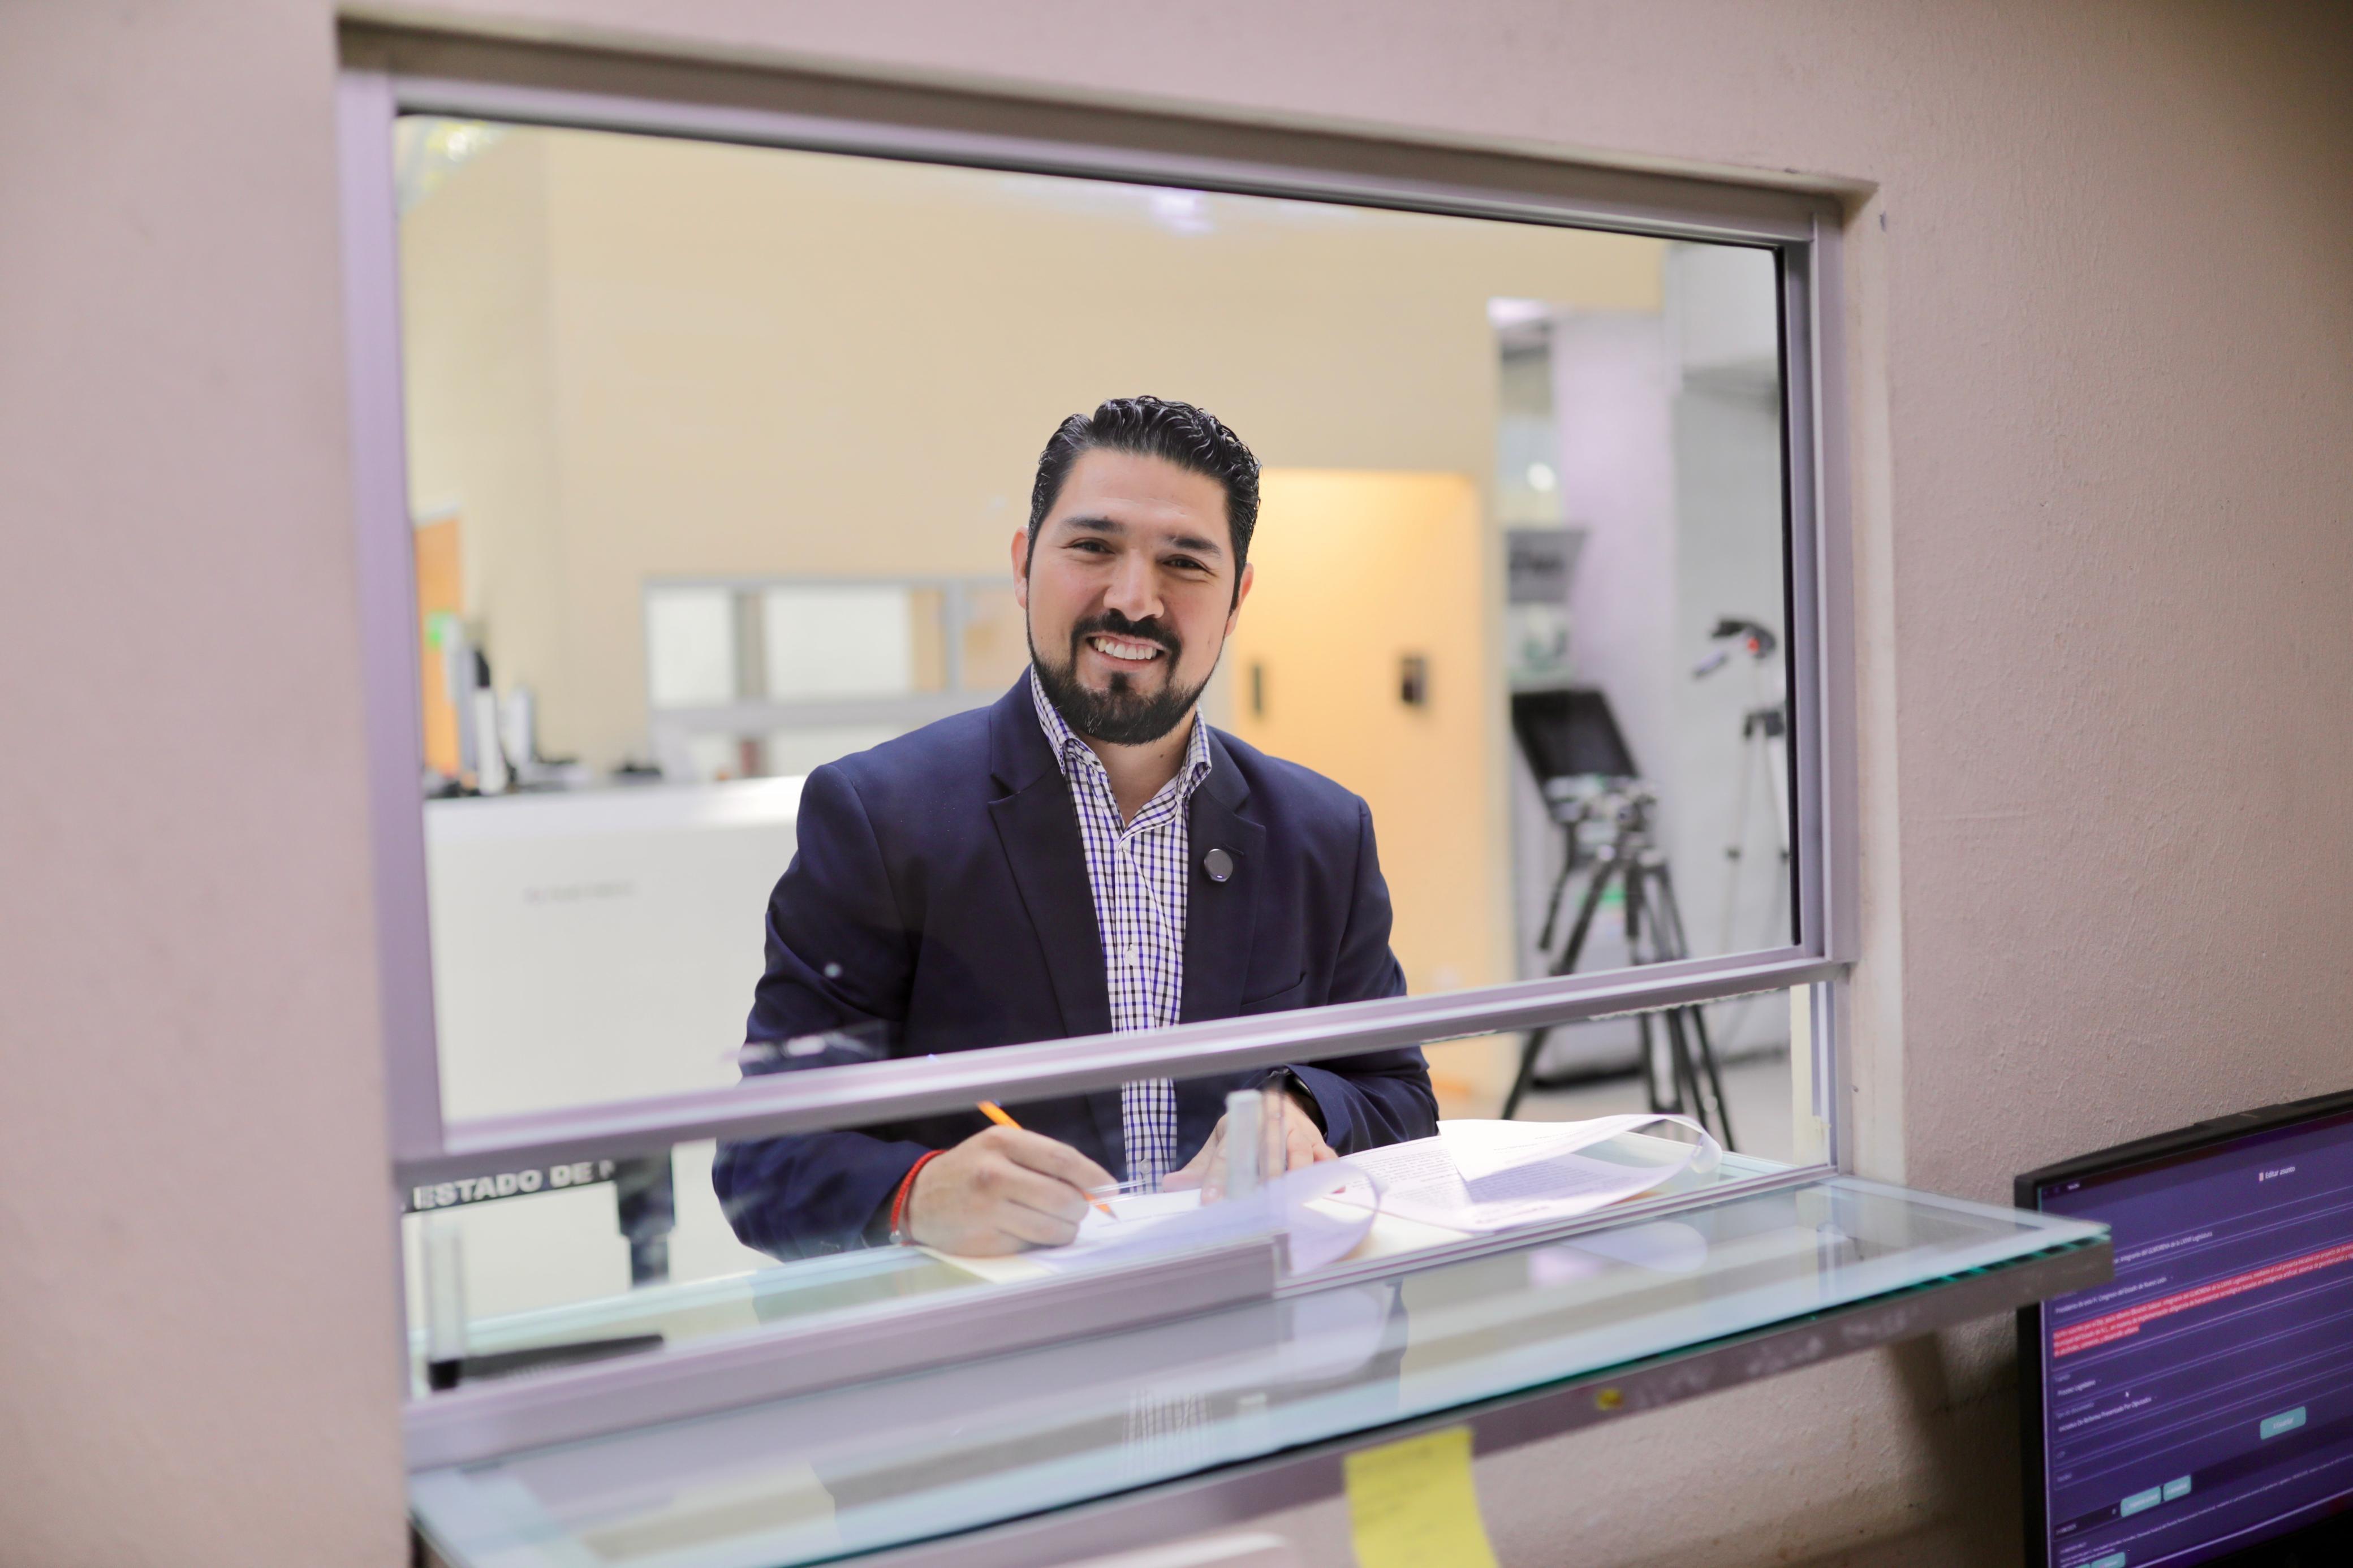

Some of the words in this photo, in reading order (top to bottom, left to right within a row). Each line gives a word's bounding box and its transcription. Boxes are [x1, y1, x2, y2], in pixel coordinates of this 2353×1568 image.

[413, 1169, 543, 1210] ESTADO
[549, 1161, 593, 1187] DE
[2265, 1170, 2279, 1179] Editar
